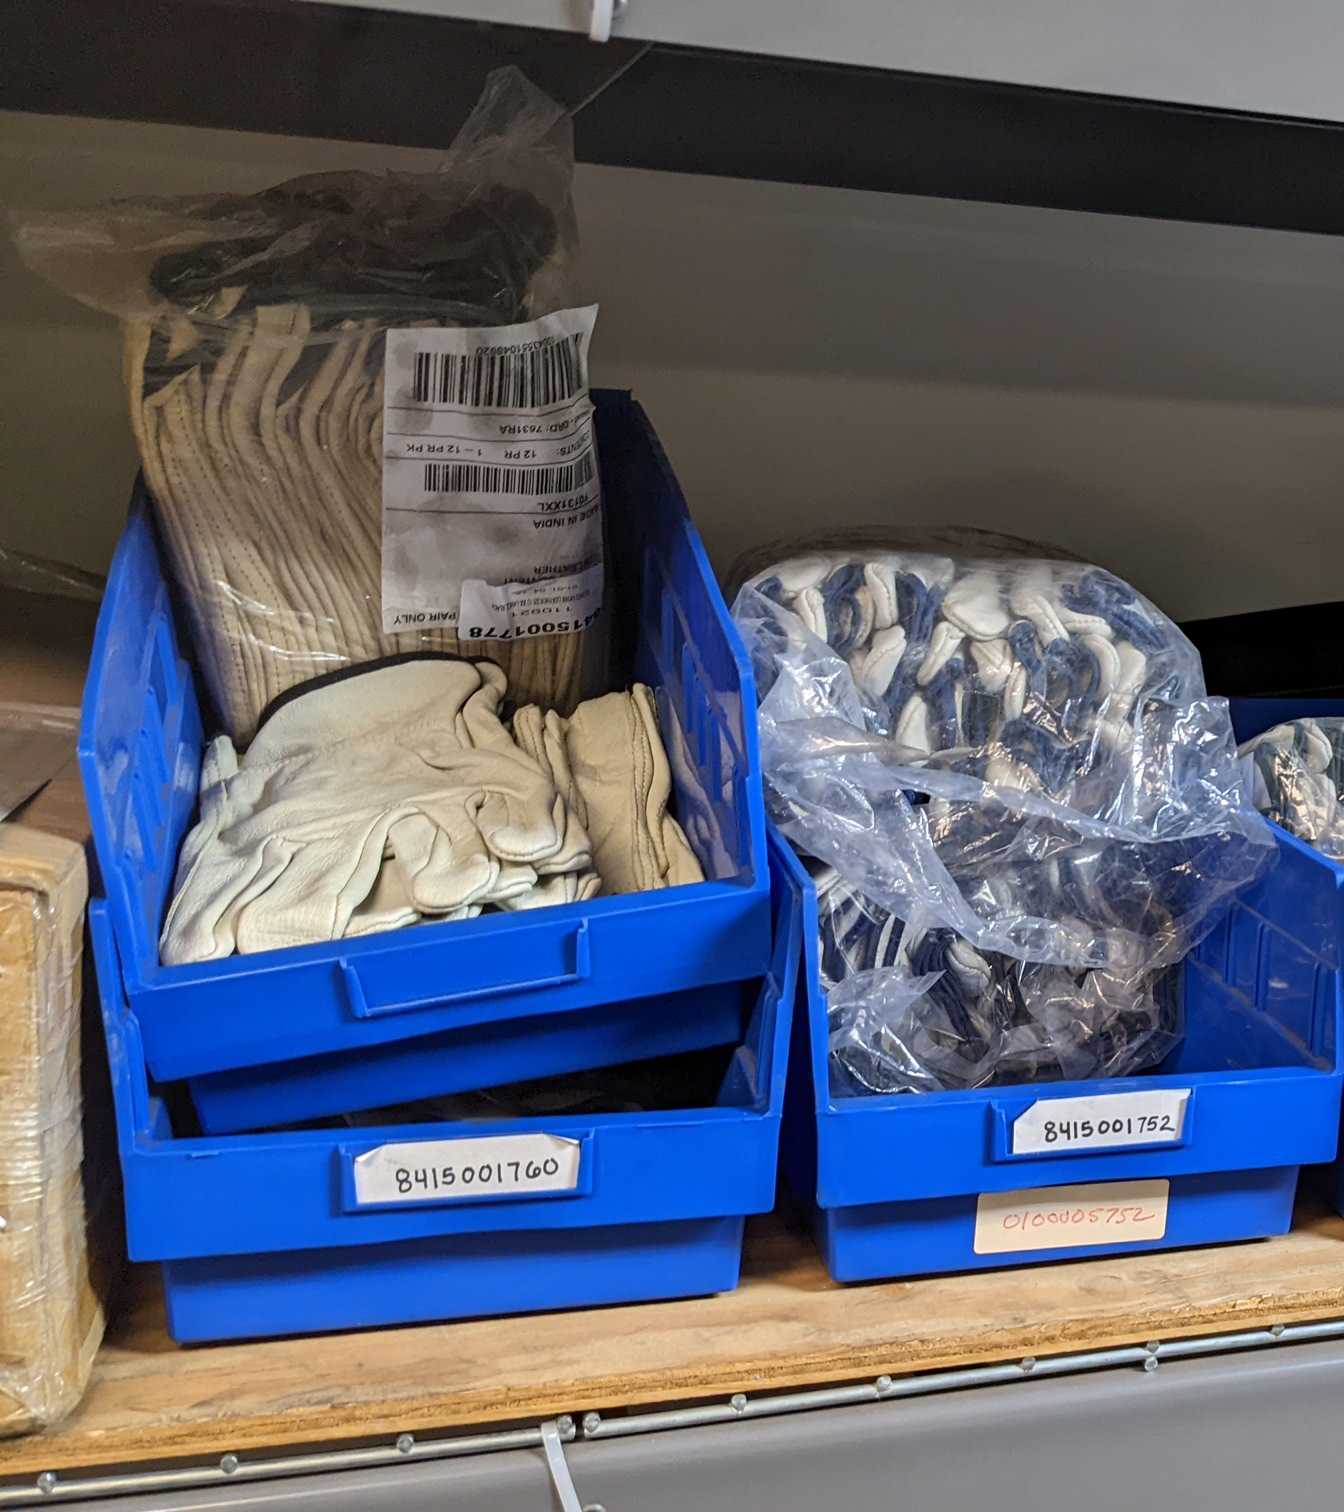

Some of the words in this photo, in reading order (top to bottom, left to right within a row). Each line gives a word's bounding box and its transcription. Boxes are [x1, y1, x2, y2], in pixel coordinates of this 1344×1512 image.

[406, 443, 423, 453] PK
[427, 444, 444, 454] PR
[447, 444, 460, 455] 12
[504, 450, 520, 459] PR
[523, 449, 537, 459] 12
[533, 518, 564, 530] INDIA
[394, 612, 425, 624] ONLY
[429, 612, 456, 622] PAIR
[1043, 1115, 1176, 1143] 8415001752
[395, 1157, 559, 1193] 8415001760
